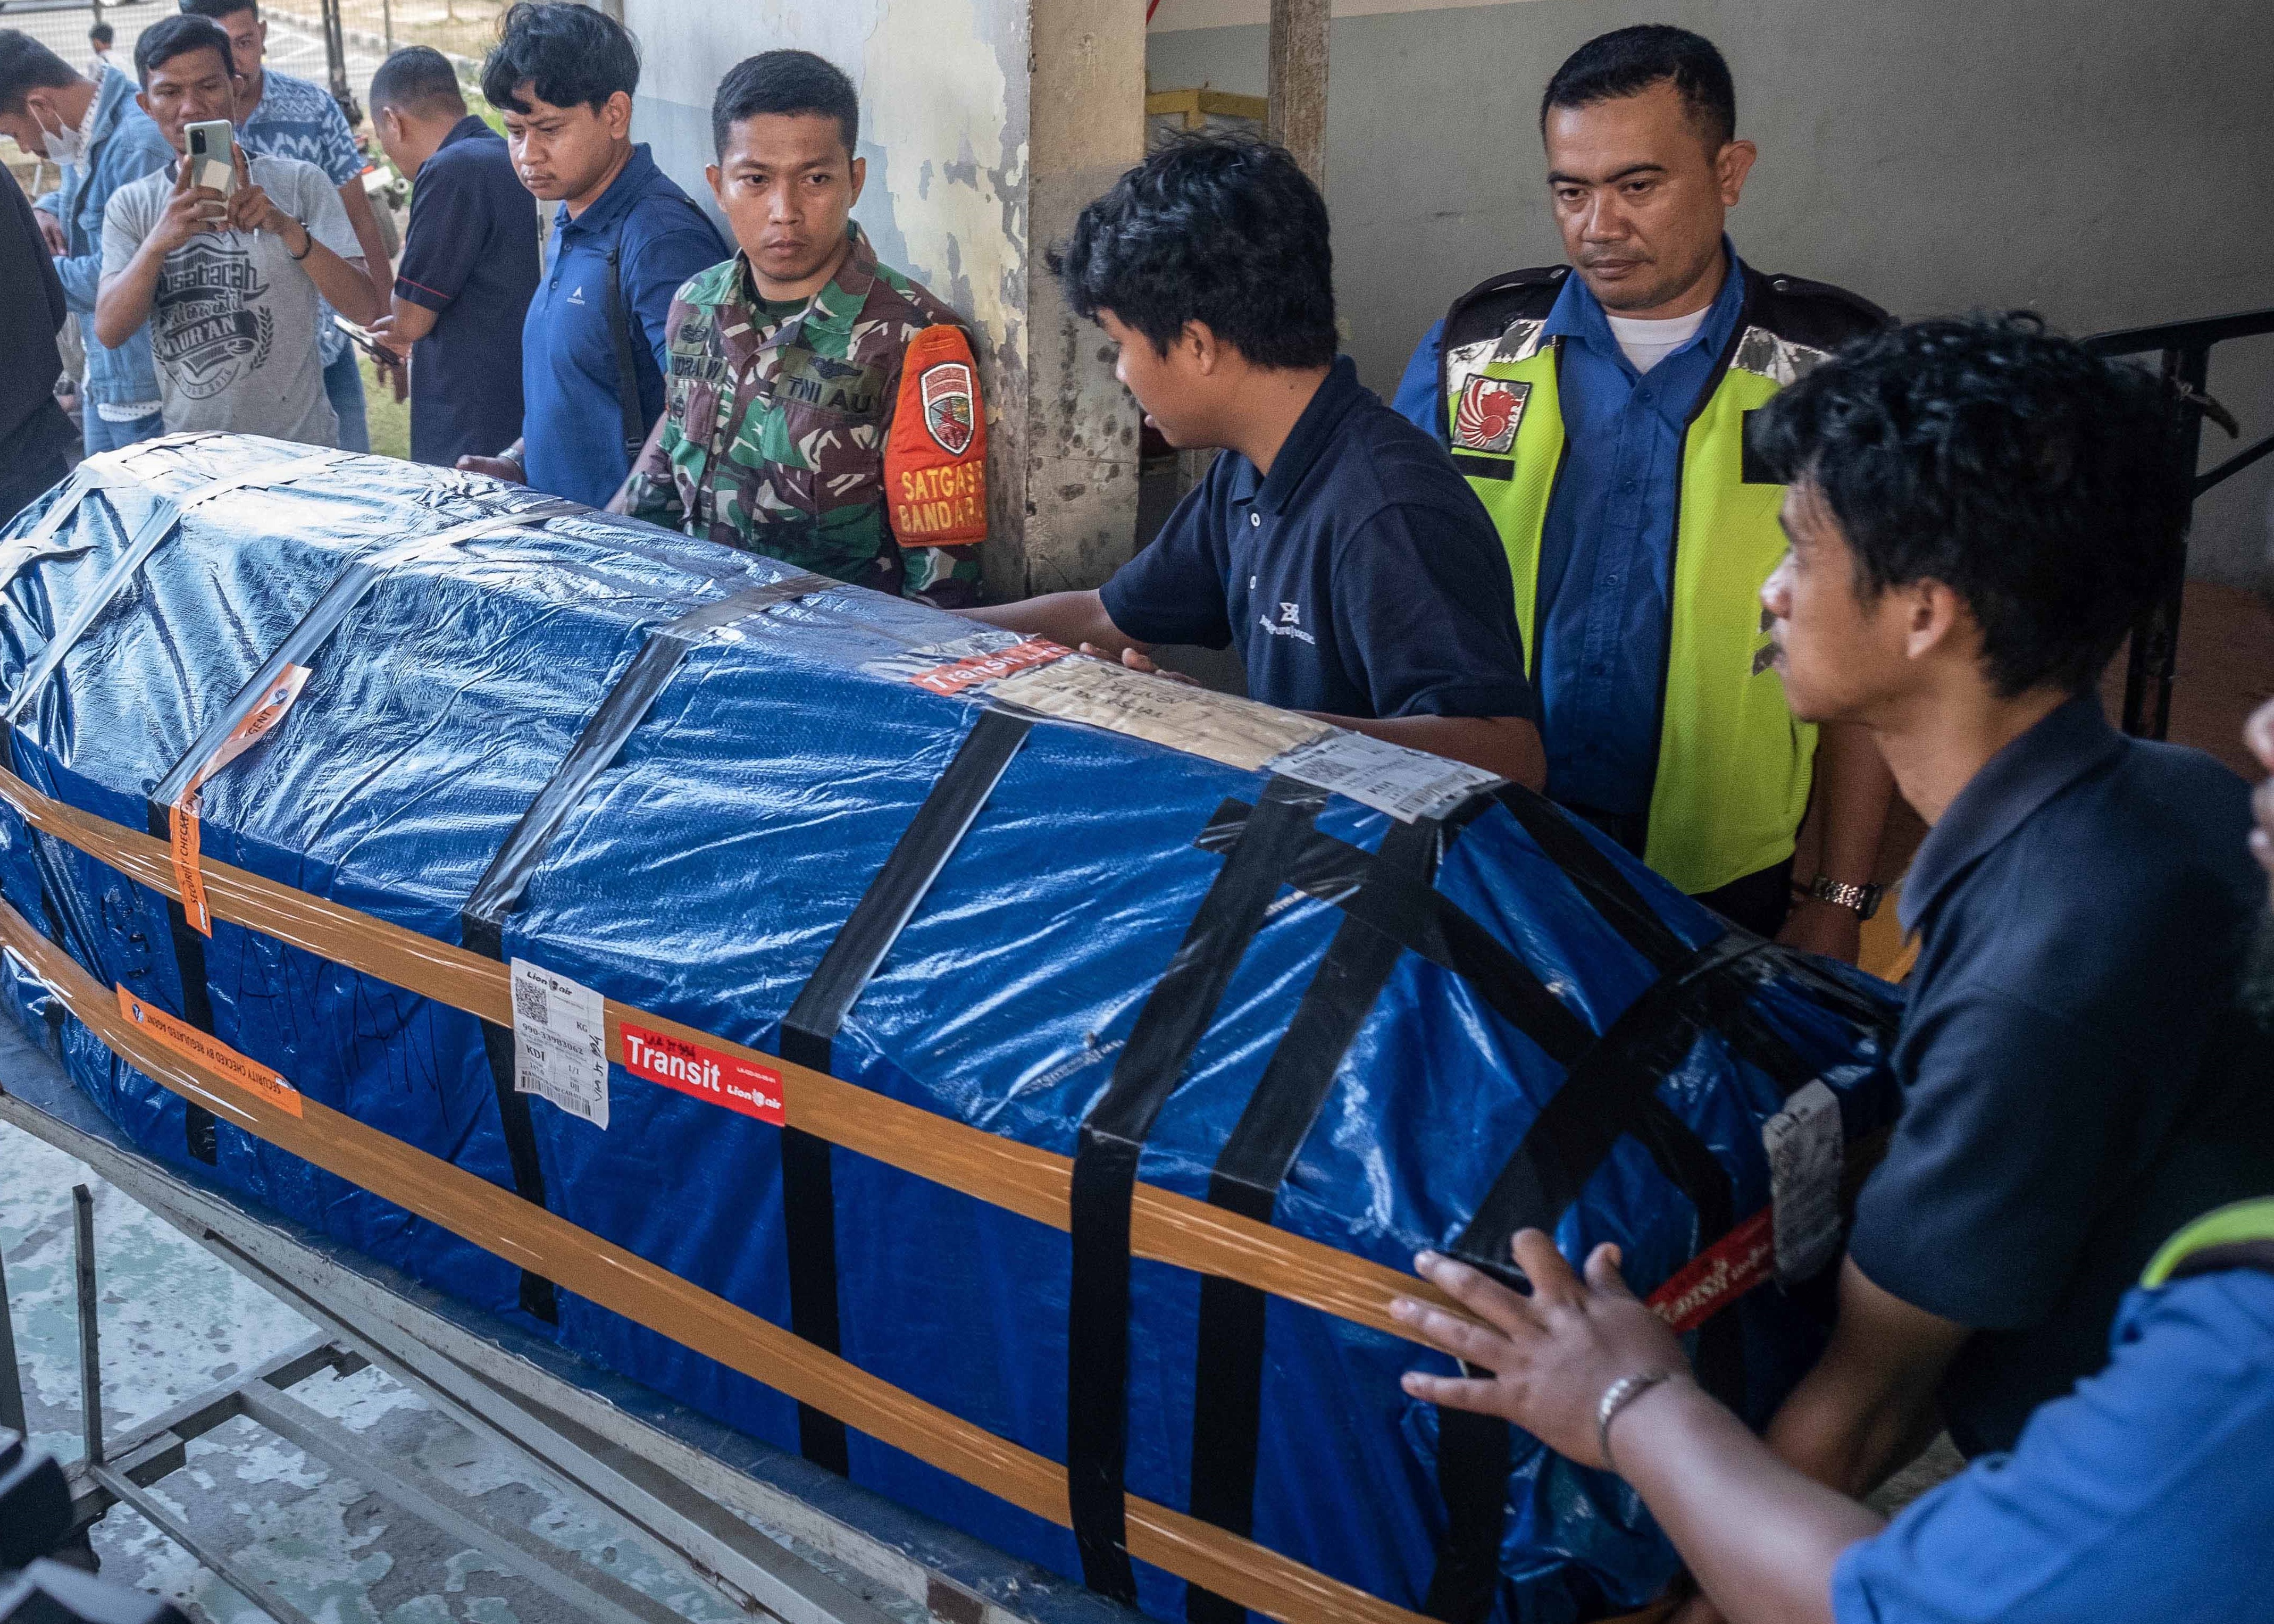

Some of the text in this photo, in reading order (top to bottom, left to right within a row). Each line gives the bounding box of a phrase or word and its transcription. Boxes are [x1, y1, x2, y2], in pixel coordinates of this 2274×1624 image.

[788, 375, 822, 404] TNI
[898, 497, 982, 532] BANDAR
[247, 709, 271, 735] GENT
[526, 971, 573, 995] Lion air
[576, 1021, 588, 1033] KG
[206, 1049, 215, 1061] BY
[216, 1052, 246, 1076] CHECKED
[526, 1044, 545, 1062] KDI
[626, 1034, 721, 1092] Transit
[248, 1068, 282, 1094] SECURITY
[727, 1084, 782, 1110] Lion air
